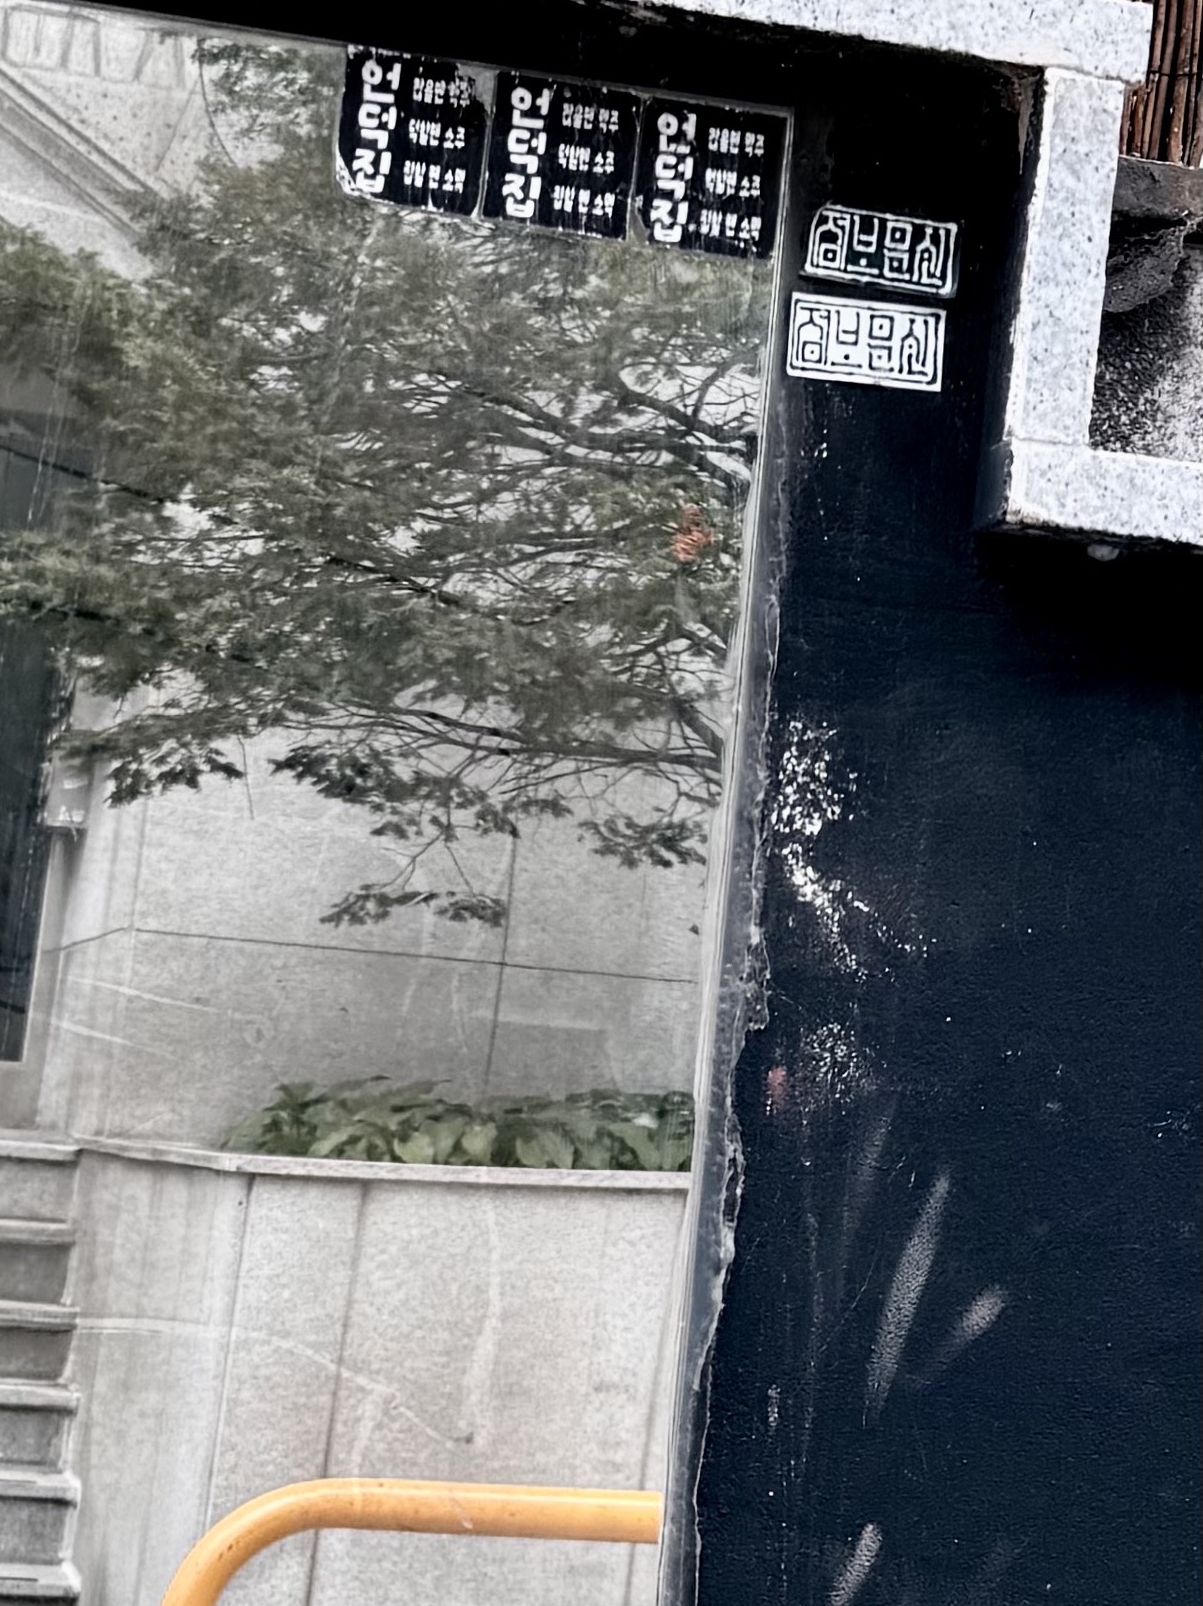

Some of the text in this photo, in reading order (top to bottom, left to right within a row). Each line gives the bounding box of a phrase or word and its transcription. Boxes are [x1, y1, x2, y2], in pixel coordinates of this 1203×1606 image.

[352, 58, 402, 193] 언덕집
[502, 86, 550, 218] 언덕집
[650, 110, 696, 243] 언덕집
